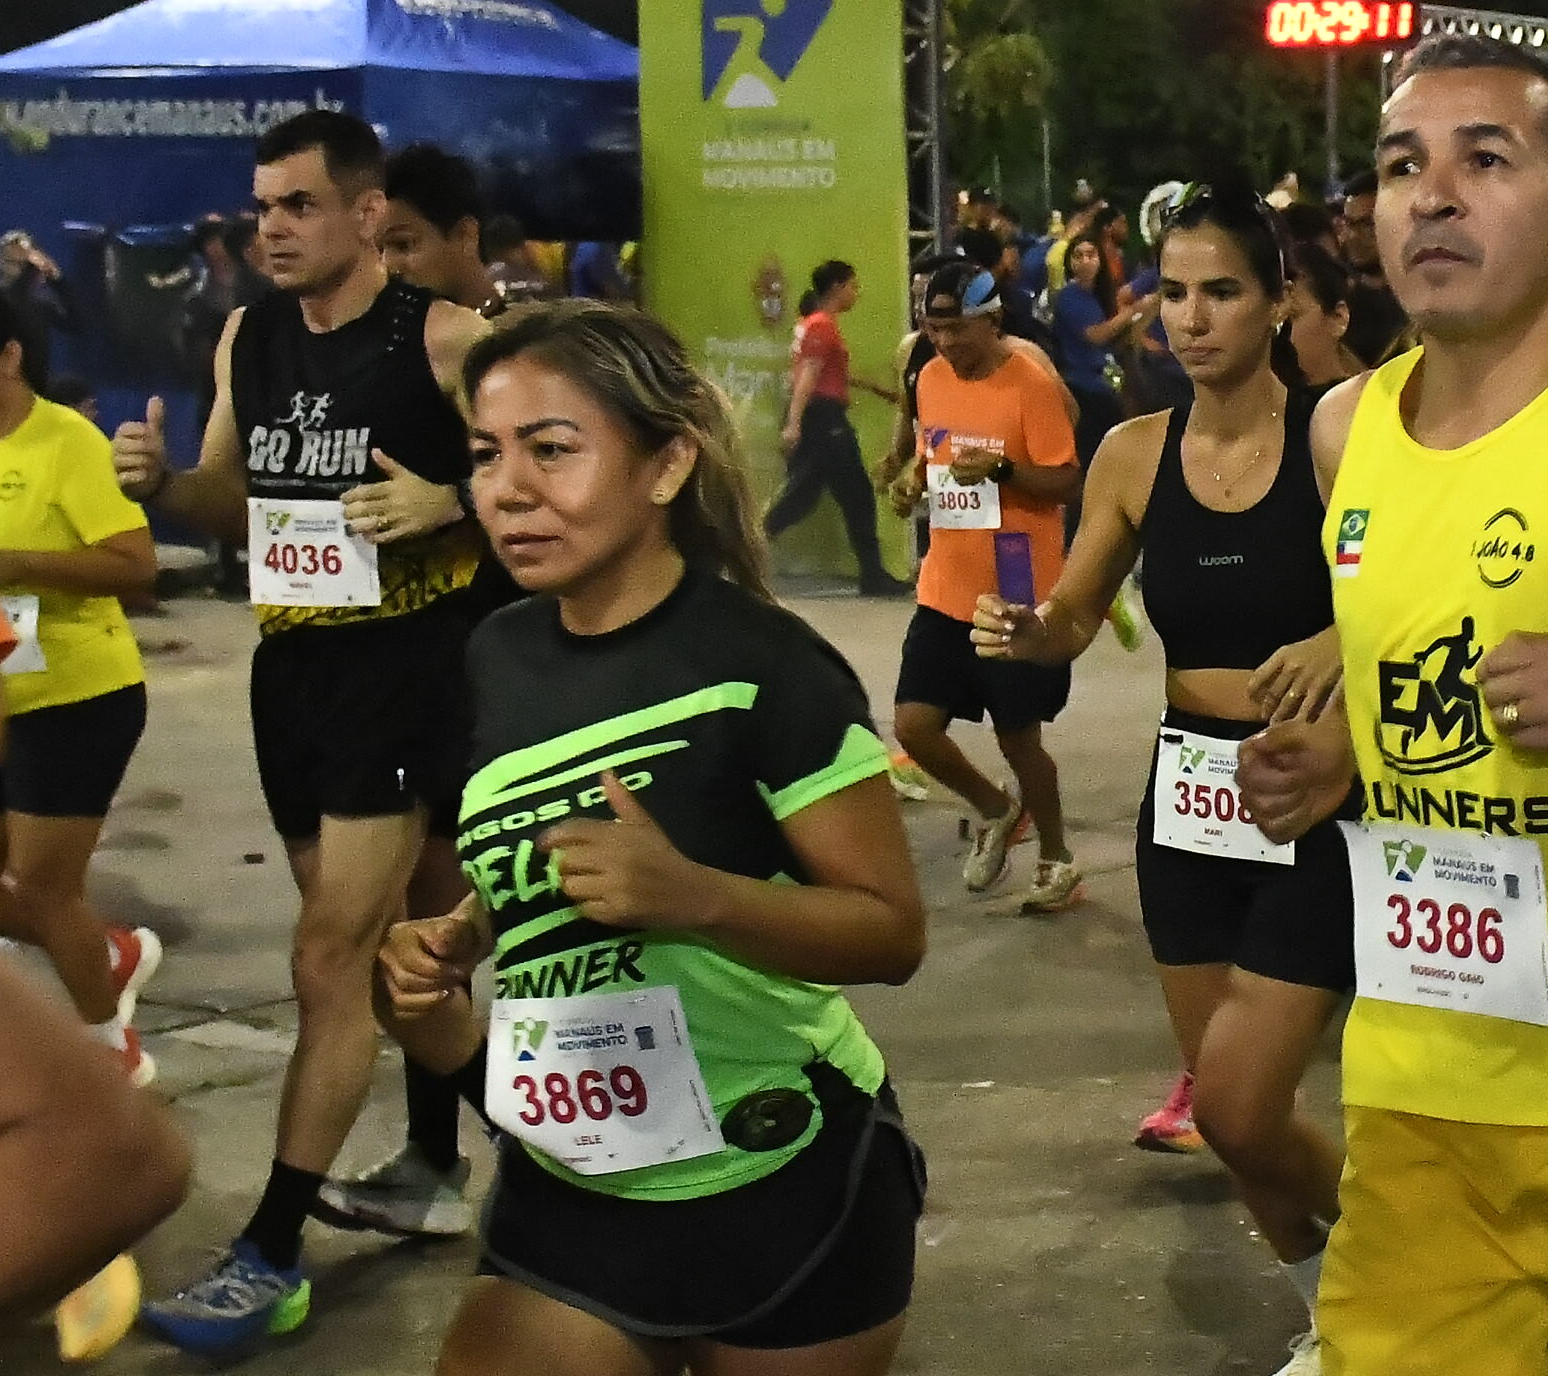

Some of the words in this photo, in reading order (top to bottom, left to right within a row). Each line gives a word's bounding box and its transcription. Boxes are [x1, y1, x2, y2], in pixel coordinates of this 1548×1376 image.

[1268, 0, 1414, 43] 00:29:11
[703, 167, 836, 189] MOVIMENTO
[248, 425, 292, 474] GO
[294, 427, 371, 476] RUN
[938, 491, 981, 511] 3803
[264, 542, 343, 576] 4036
[1207, 756, 1238, 768] MANAU
[1386, 892, 1505, 964] 3386
[605, 1022, 625, 1035] EM
[513, 1064, 648, 1127] 3869
